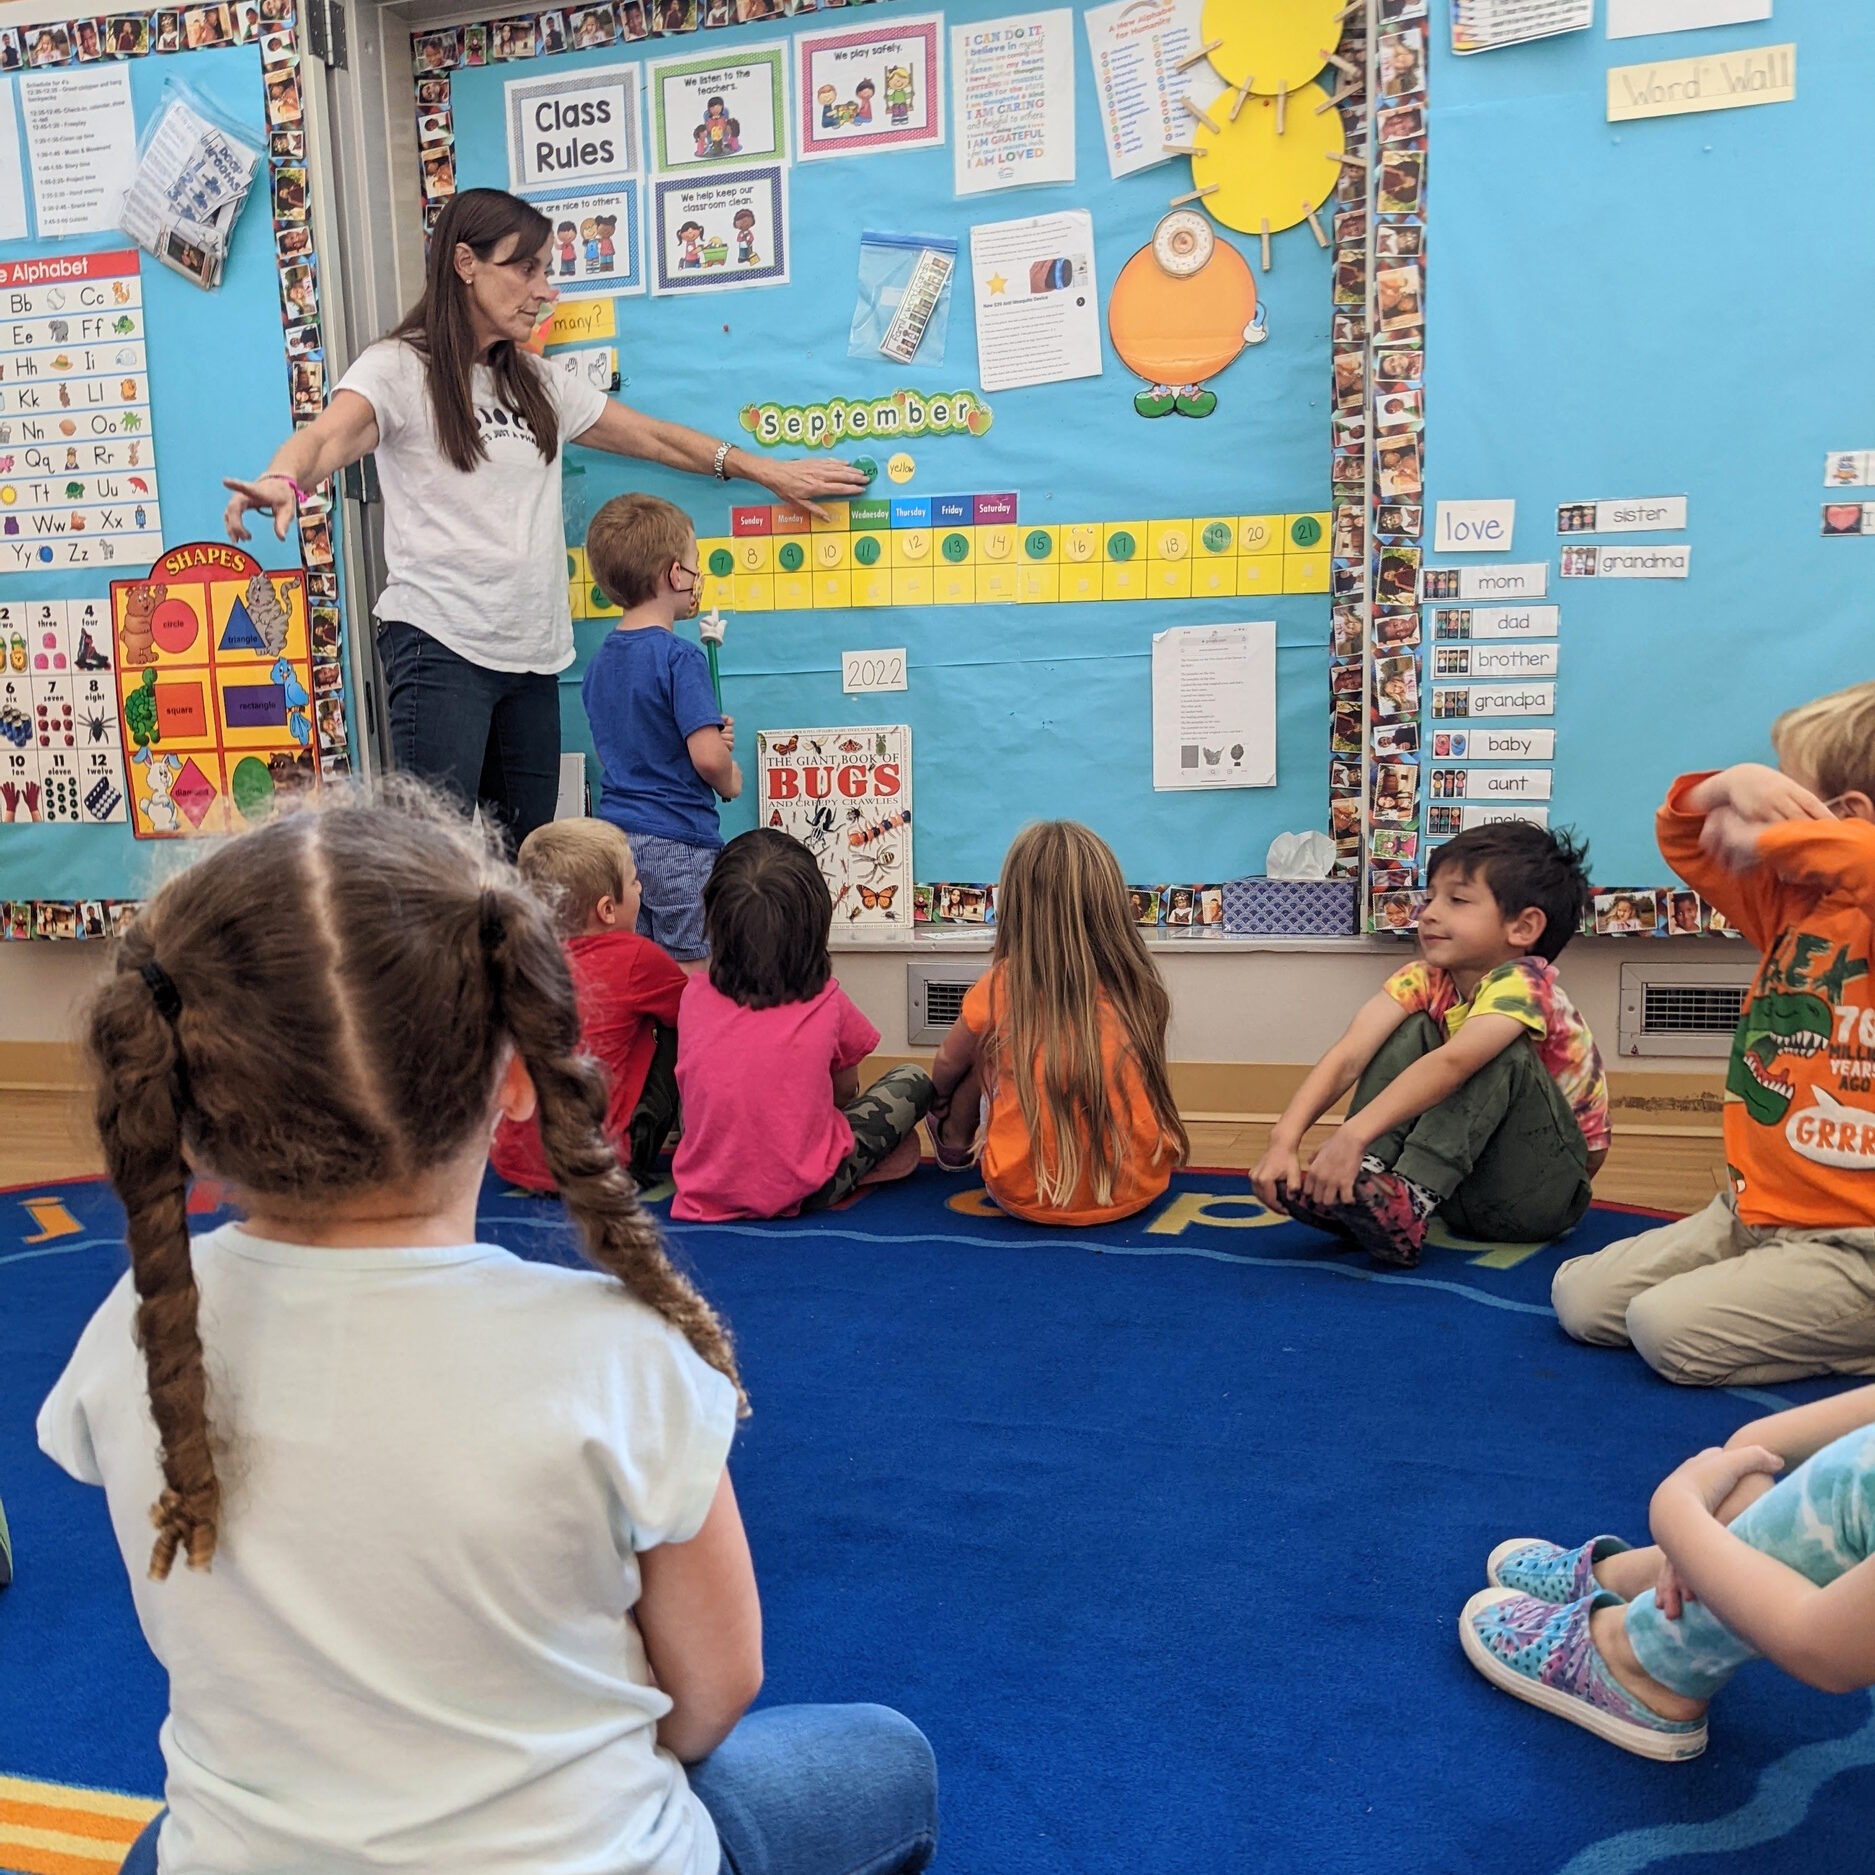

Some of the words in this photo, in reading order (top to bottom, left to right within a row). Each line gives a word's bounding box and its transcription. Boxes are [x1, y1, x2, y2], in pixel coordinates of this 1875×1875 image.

[974, 32, 1000, 45] CAN
[1005, 28, 1024, 40] DO
[834, 51, 847, 61] We
[850, 48, 869, 62] play
[684, 78, 697, 86] We
[700, 74, 722, 84] listen
[724, 72, 734, 80] to
[736, 70, 750, 78] the
[1622, 69, 1701, 106] Word
[1722, 52, 1790, 94] Wall
[698, 83, 738, 96] teachers.
[535, 100, 611, 132] Class
[975, 106, 994, 118] AM
[997, 98, 1044, 114] CARING
[974, 138, 988, 148] AM
[991, 130, 1044, 145] GRATEFUL
[536, 138, 614, 174] Rules
[975, 155, 994, 168] AM
[998, 148, 1044, 164] LOVED
[681, 194, 694, 202] We
[696, 191, 714, 200] help
[716, 188, 736, 198] keep
[740, 186, 754, 194] our
[546, 204, 560, 212] are
[562, 202, 578, 210] nice
[582, 200, 590, 208] to
[592, 197, 621, 206] others.
[683, 201, 726, 212] classroom
[12, 257, 88, 283] Alphabet
[10, 294, 32, 313] Bb
[80, 287, 104, 306] Cc
[554, 304, 602, 334] many?
[13, 326, 33, 345] Ee
[82, 318, 104, 338] Ff
[16, 357, 38, 376] Hh
[84, 351, 96, 370] Ii
[19, 388, 40, 408] Kk
[88, 382, 104, 402] Ll
[91, 415, 117, 434] Oo
[764, 401, 968, 438] September
[22, 421, 44, 440] Nn
[25, 448, 56, 474] Qq
[94, 446, 114, 465] Rr
[890, 462, 914, 475] yellow
[29, 484, 50, 503] Tt
[98, 478, 118, 498] Uu
[852, 510, 889, 520] Wednesday
[896, 508, 926, 518] Thursday
[942, 506, 964, 516] Friday
[979, 504, 1010, 514] Saturday
[1614, 506, 1668, 524] sister
[32, 514, 66, 534] Ww
[101, 510, 122, 530] Xx
[740, 516, 764, 526] Sunday
[778, 514, 804, 524] Monday
[1446, 512, 1504, 542] love
[1210, 528, 1223, 544] 19
[1248, 527, 1264, 542] 20
[1298, 523, 1312, 540] 21
[908, 535, 922, 548] 12
[949, 540, 962, 554] 13
[992, 536, 1006, 549] 14
[1032, 536, 1044, 550] 15
[1073, 540, 1086, 554] 16
[1114, 538, 1126, 554] 17
[1166, 538, 1178, 552] 18
[12, 544, 32, 568] Yy
[68, 544, 88, 562] Zz
[748, 548, 758, 564] 8
[786, 549, 794, 562] 9
[824, 546, 836, 559] 10
[862, 544, 871, 556] 11
[166, 548, 246, 576] SHAPES
[717, 557, 724, 570] 7
[1602, 554, 1684, 572] grandma
[1478, 574, 1525, 590] mom
[0, 608, 10, 620] 2
[42, 606, 50, 618] 3
[84, 605, 94, 617] 4
[38, 619, 57, 628] three
[82, 618, 98, 626] four
[163, 620, 184, 629] circle
[1498, 614, 1530, 630] dad
[228, 634, 258, 645] triangle
[1478, 652, 1550, 668] brother
[848, 658, 902, 687] 2022
[6, 682, 14, 694] 6
[48, 681, 56, 692] 7
[90, 680, 98, 692] 8
[44, 694, 64, 702] seven
[85, 694, 104, 702] eight
[1474, 692, 1546, 712] grandpa
[166, 706, 193, 716] square
[240, 702, 276, 711] rectangle
[1488, 736, 1532, 755] baby
[10, 756, 25, 767] 10
[54, 755, 64, 766] 11
[91, 754, 107, 766] 12
[767, 757, 792, 766] THE
[796, 755, 836, 766] GIANT
[842, 754, 876, 764] BOOK
[882, 753, 899, 763] OF
[48, 768, 72, 776] eleven
[87, 767, 113, 776] twelve
[767, 763, 900, 800] BUGS
[1488, 776, 1528, 792] aunt
[768, 800, 792, 808] AND
[796, 799, 838, 807] CREEPY
[842, 798, 898, 806] CRAWLIES
[1838, 1076, 1870, 1092] AGO
